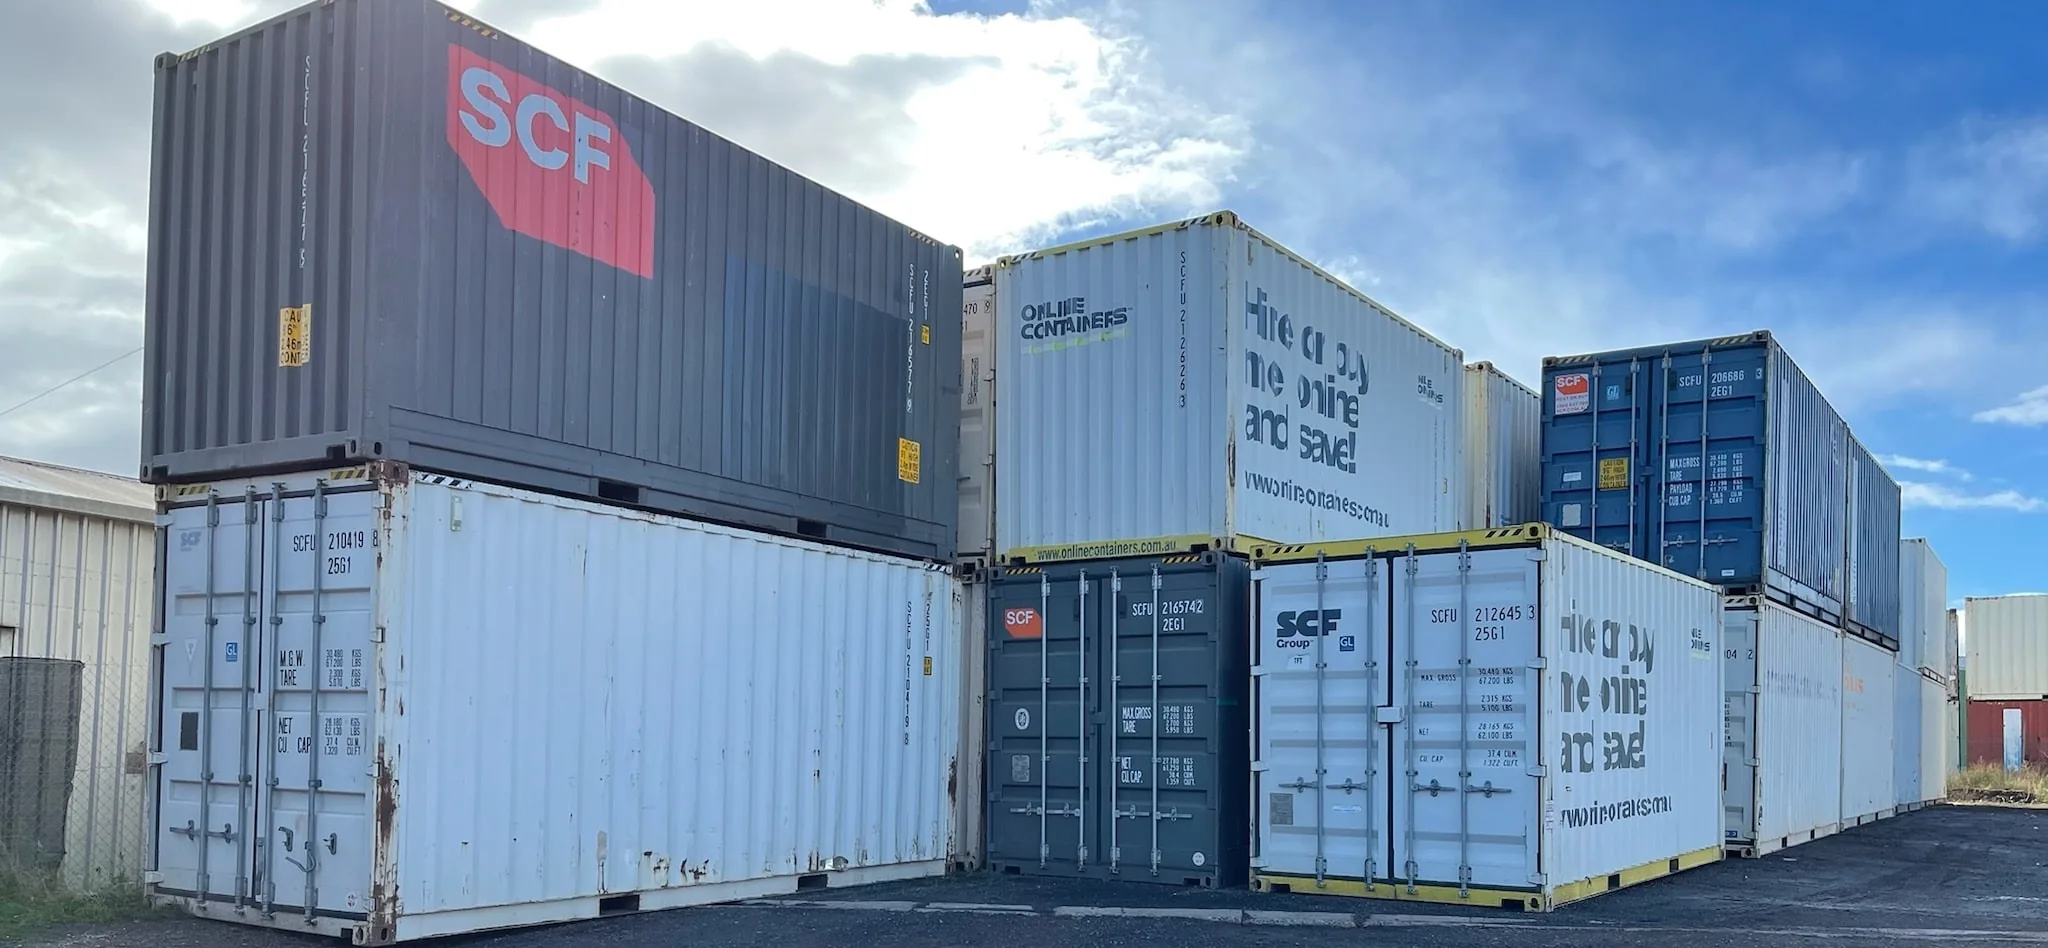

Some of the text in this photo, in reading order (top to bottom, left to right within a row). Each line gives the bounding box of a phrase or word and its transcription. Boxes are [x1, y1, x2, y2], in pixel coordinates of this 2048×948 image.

[458, 66, 612, 185] SCF
[1244, 280, 1294, 352] Hire
[1301, 325, 1326, 365] or
[1557, 376, 1581, 388] SCF
[1679, 368, 1763, 387] SCFU 206686 3
[1244, 347, 1359, 428] me online
[1711, 385, 1733, 397] 2EG1
[1180, 394, 1186, 408] 3
[1244, 403, 1356, 474] and save!
[1669, 470, 1682, 480] TARE
[1669, 482, 1692, 494] PAYLOAD
[293, 530, 379, 552] SCFU 210419 8
[1037, 541, 1177, 562] www.onlinecontainers.com.au
[327, 557, 351, 575] 25G1
[1132, 602, 1153, 616] SCFU
[1431, 605, 1536, 623] SCFU 212645 3
[1006, 611, 1034, 625] SCF
[1162, 618, 1185, 631] 2EG1
[1276, 609, 1342, 638] SCF
[1475, 625, 1504, 641] 25G1
[226, 643, 238, 656] GL
[1276, 639, 1310, 649] Group
[352, 649, 362, 658] KGS
[351, 658, 362, 668] LBS
[280, 669, 297, 686] TARE
[351, 669, 361, 678] KGS
[1503, 667, 1514, 675] KGS
[351, 678, 361, 687] LBS
[1437, 674, 1457, 682] GROSS
[1503, 676, 1514, 685] LBS
[1599, 664, 1647, 717] onine
[1502, 695, 1512, 703] KGS
[1419, 701, 1434, 709] TARE
[1502, 704, 1513, 712] LBS
[278, 717, 293, 734] NET
[350, 718, 361, 727] KGS
[350, 727, 360, 736] LBS
[1122, 720, 1136, 733] TARE
[1418, 728, 1429, 736] NET
[1502, 731, 1513, 739] LBS
[1561, 719, 1595, 773] and
[1121, 756, 1132, 770] NET
